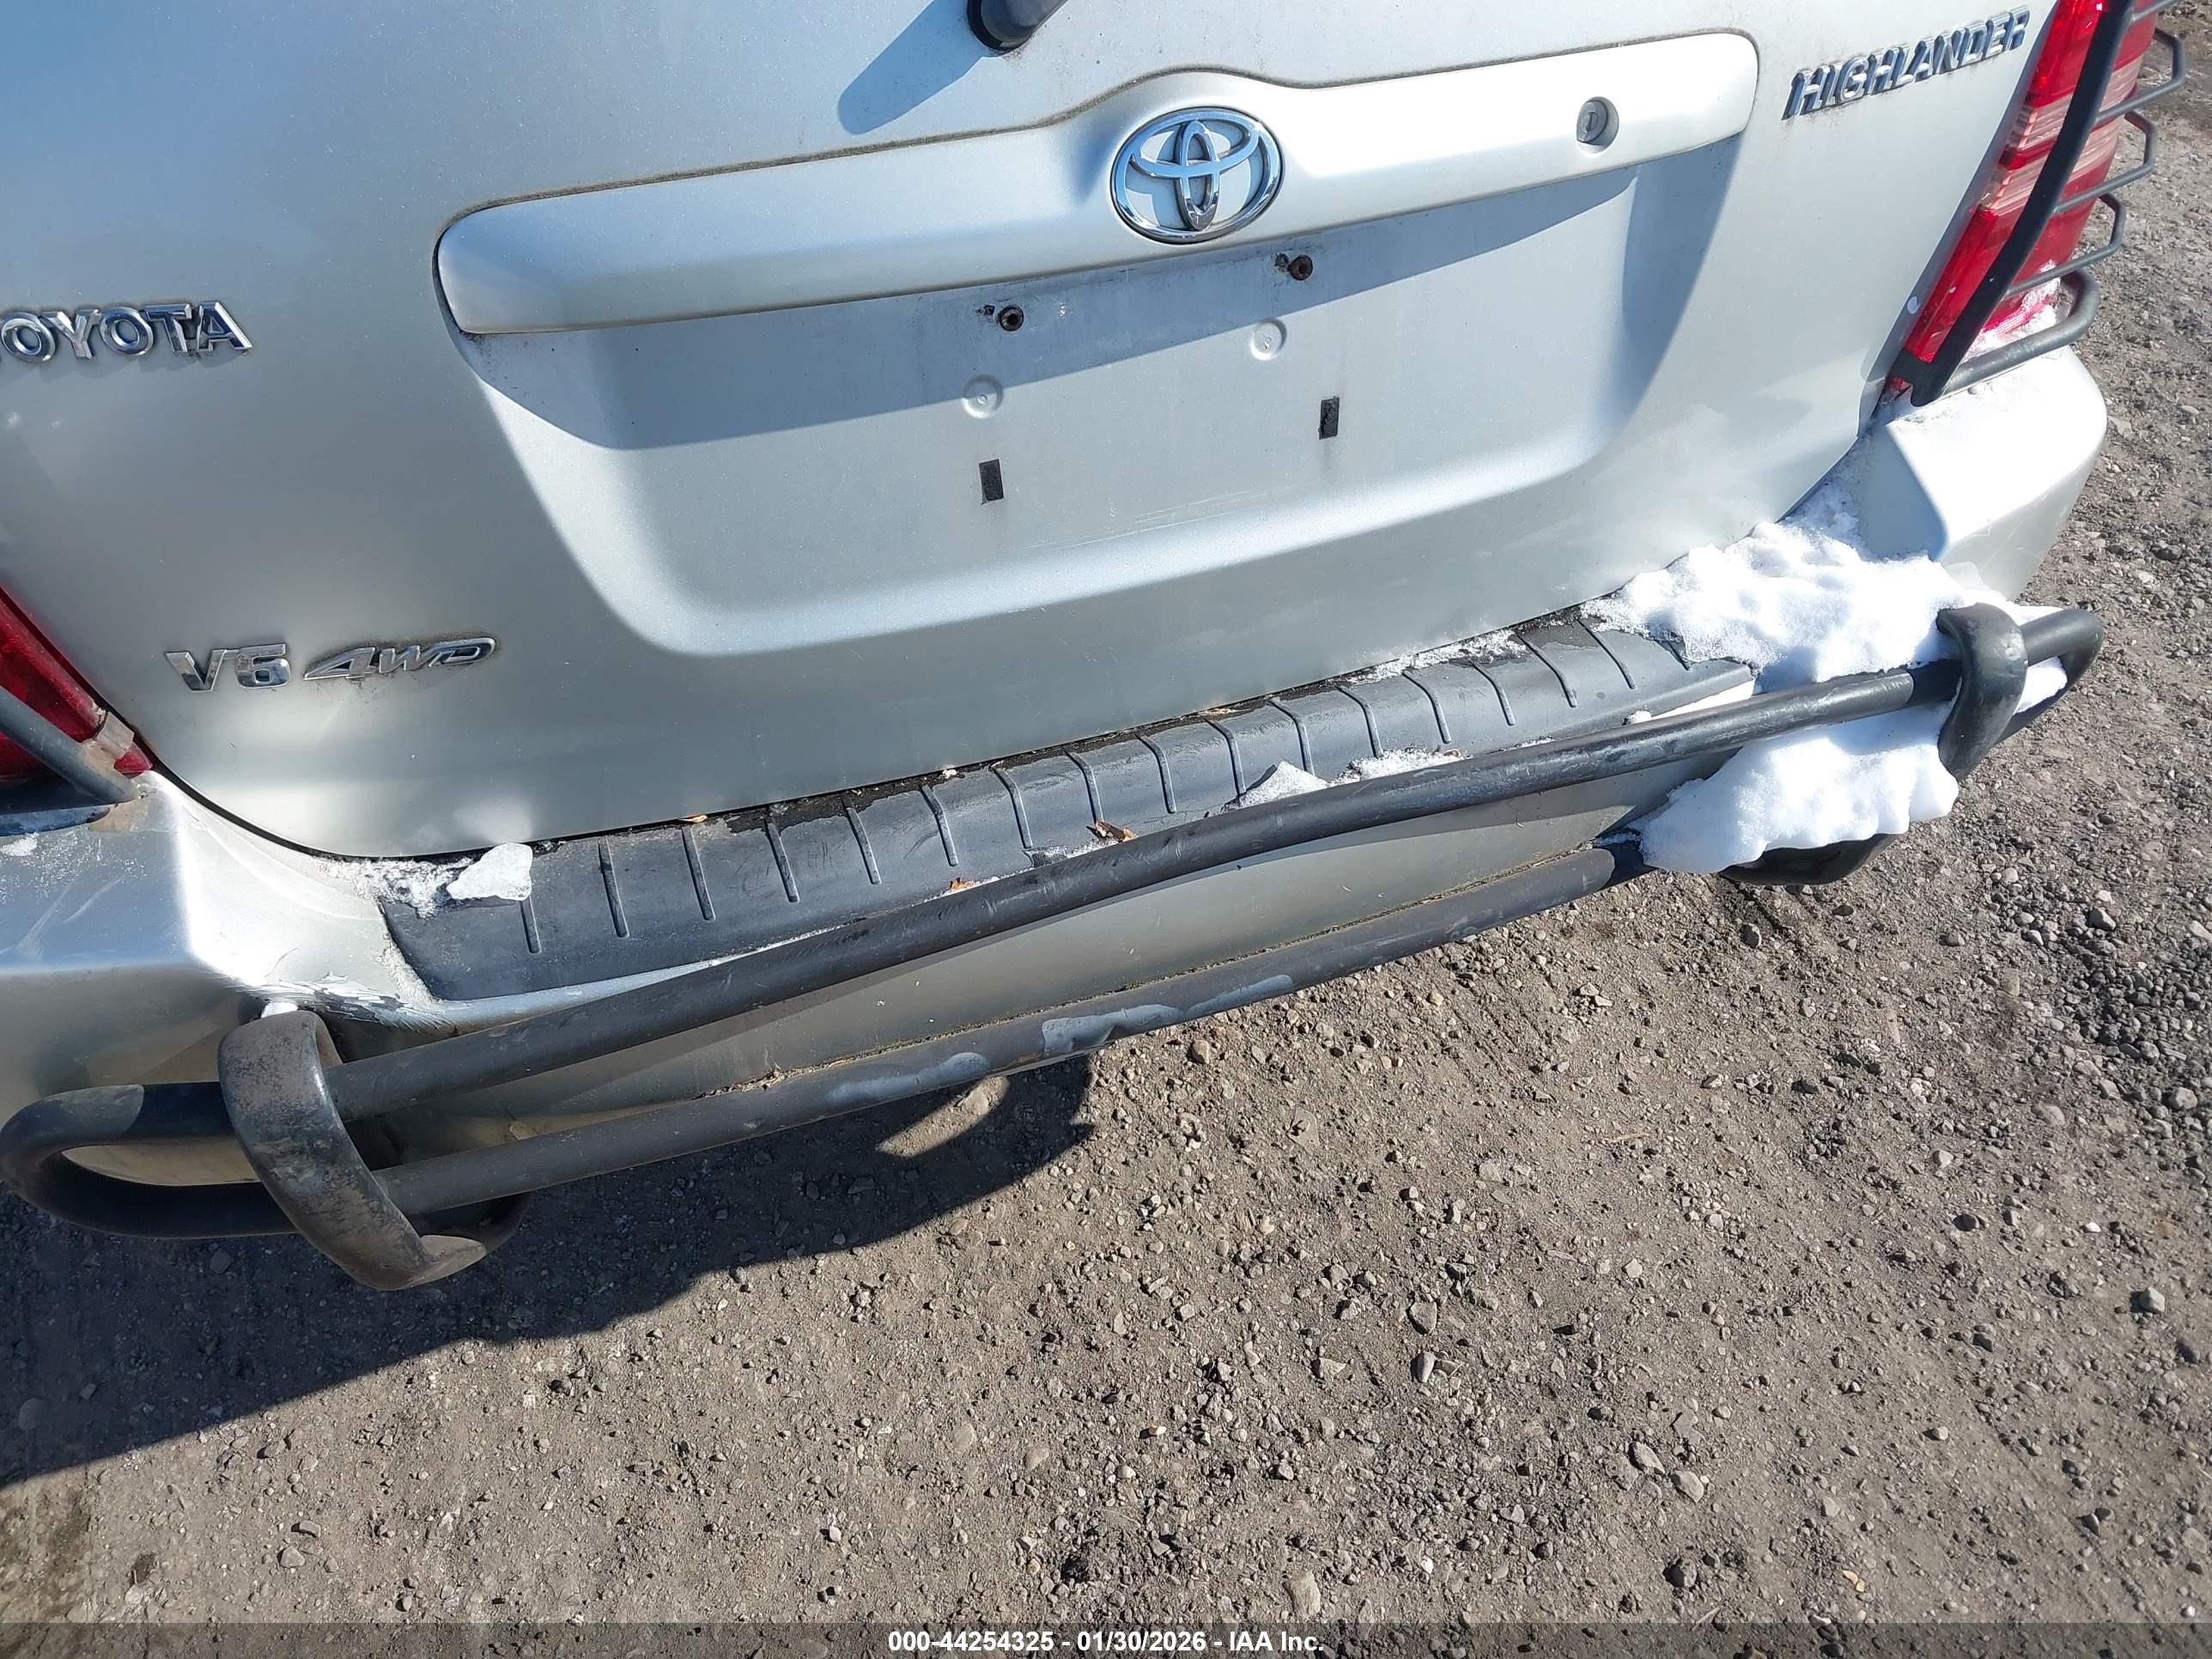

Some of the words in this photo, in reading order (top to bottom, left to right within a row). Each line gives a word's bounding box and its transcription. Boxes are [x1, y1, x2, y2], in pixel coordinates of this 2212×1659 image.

[1782, 7, 2030, 120] HIGHLANDER
[0, 301, 252, 362] OYOTA
[165, 642, 290, 692] V6
[303, 637, 496, 681] 4WD
